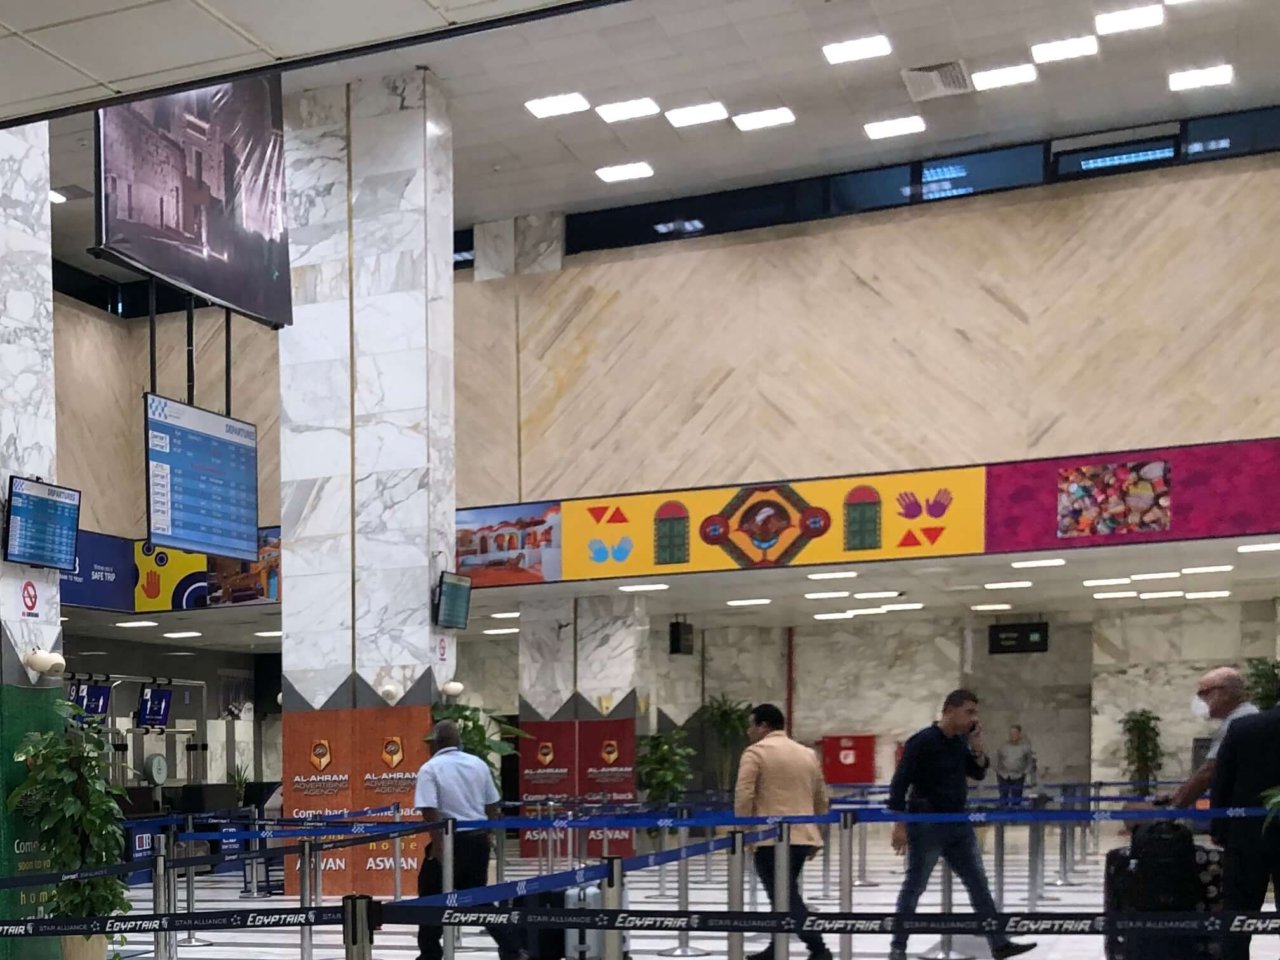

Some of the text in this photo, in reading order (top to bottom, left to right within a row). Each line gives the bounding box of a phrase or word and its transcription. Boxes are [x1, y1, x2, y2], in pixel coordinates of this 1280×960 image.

[48, 488, 76, 501] DEPARTURES
[91, 571, 104, 581] SAFE
[104, 572, 116, 582] TRIP
[70, 685, 76, 700] 9
[293, 774, 349, 782] AL-AHRAM
[294, 781, 349, 789] ADVERTISING
[303, 788, 339, 796] AGENCY
[136, 834, 151, 850] CIB
[58, 924, 88, 932] ALLIANCE
[105, 919, 160, 931] EGYPTAIR
[193, 918, 228, 926] ALLIANCE
[247, 913, 306, 926] EGYPTAIR
[441, 910, 510, 924] EGYPTAIR
[615, 914, 688, 928] EGYPTAIR
[707, 919, 731, 927] STAR
[733, 919, 777, 927] ALLIANCE
[802, 916, 881, 931] EGYPTAIR
[1005, 917, 1091, 932] EGYPTAIR
